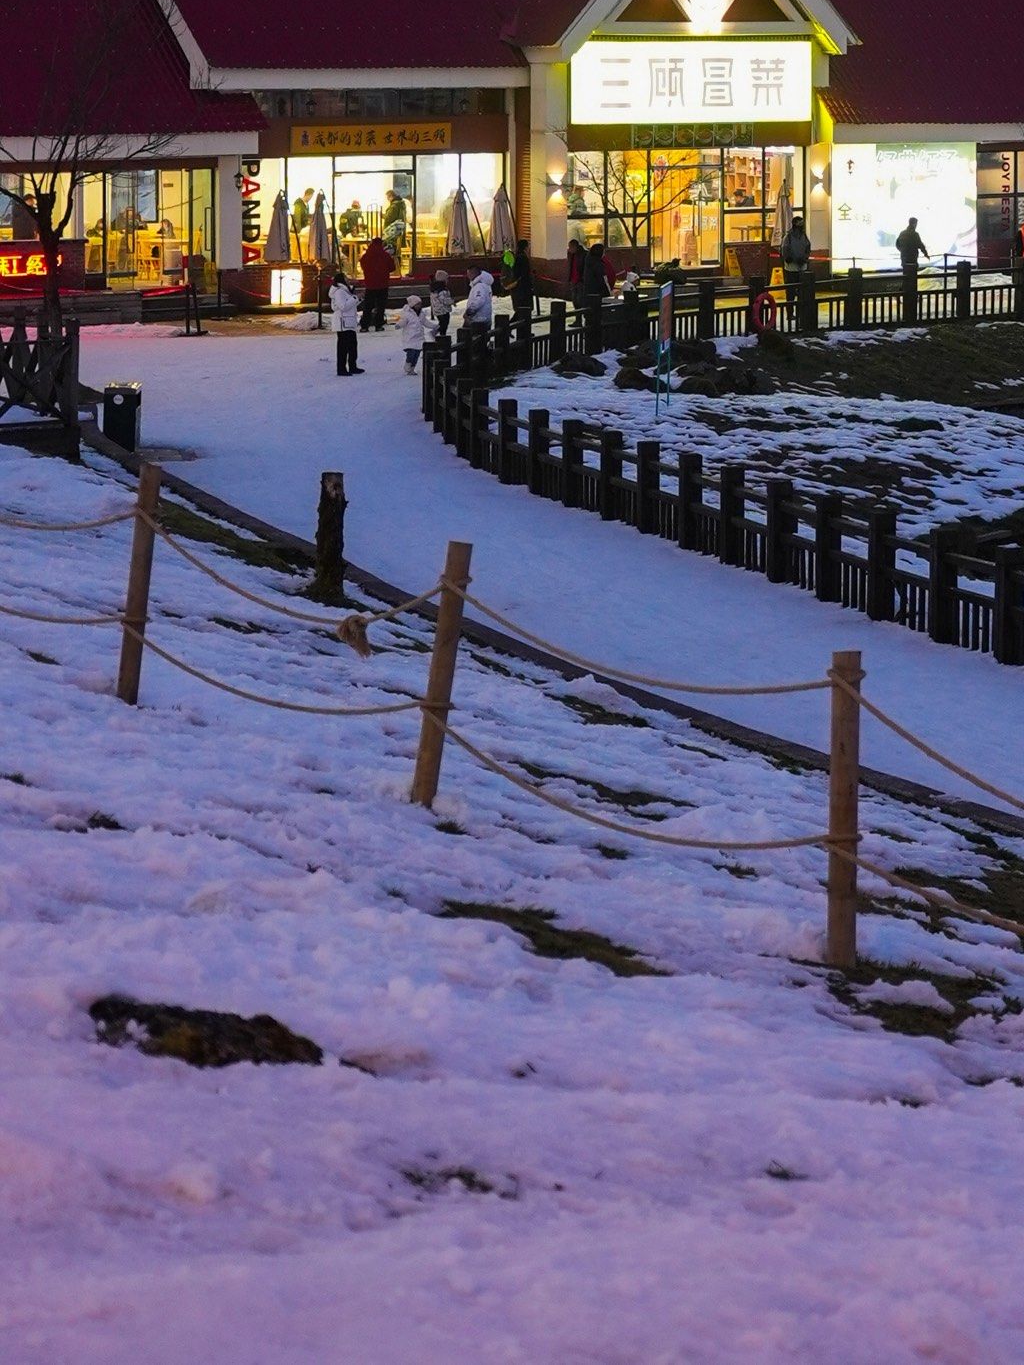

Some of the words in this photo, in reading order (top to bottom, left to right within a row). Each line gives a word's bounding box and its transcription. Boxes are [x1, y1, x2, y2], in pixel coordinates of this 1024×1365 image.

[600, 58, 786, 108] 三顾冒菜
[1002, 154, 1011, 180] JOY
[242, 159, 261, 265] PANDA
